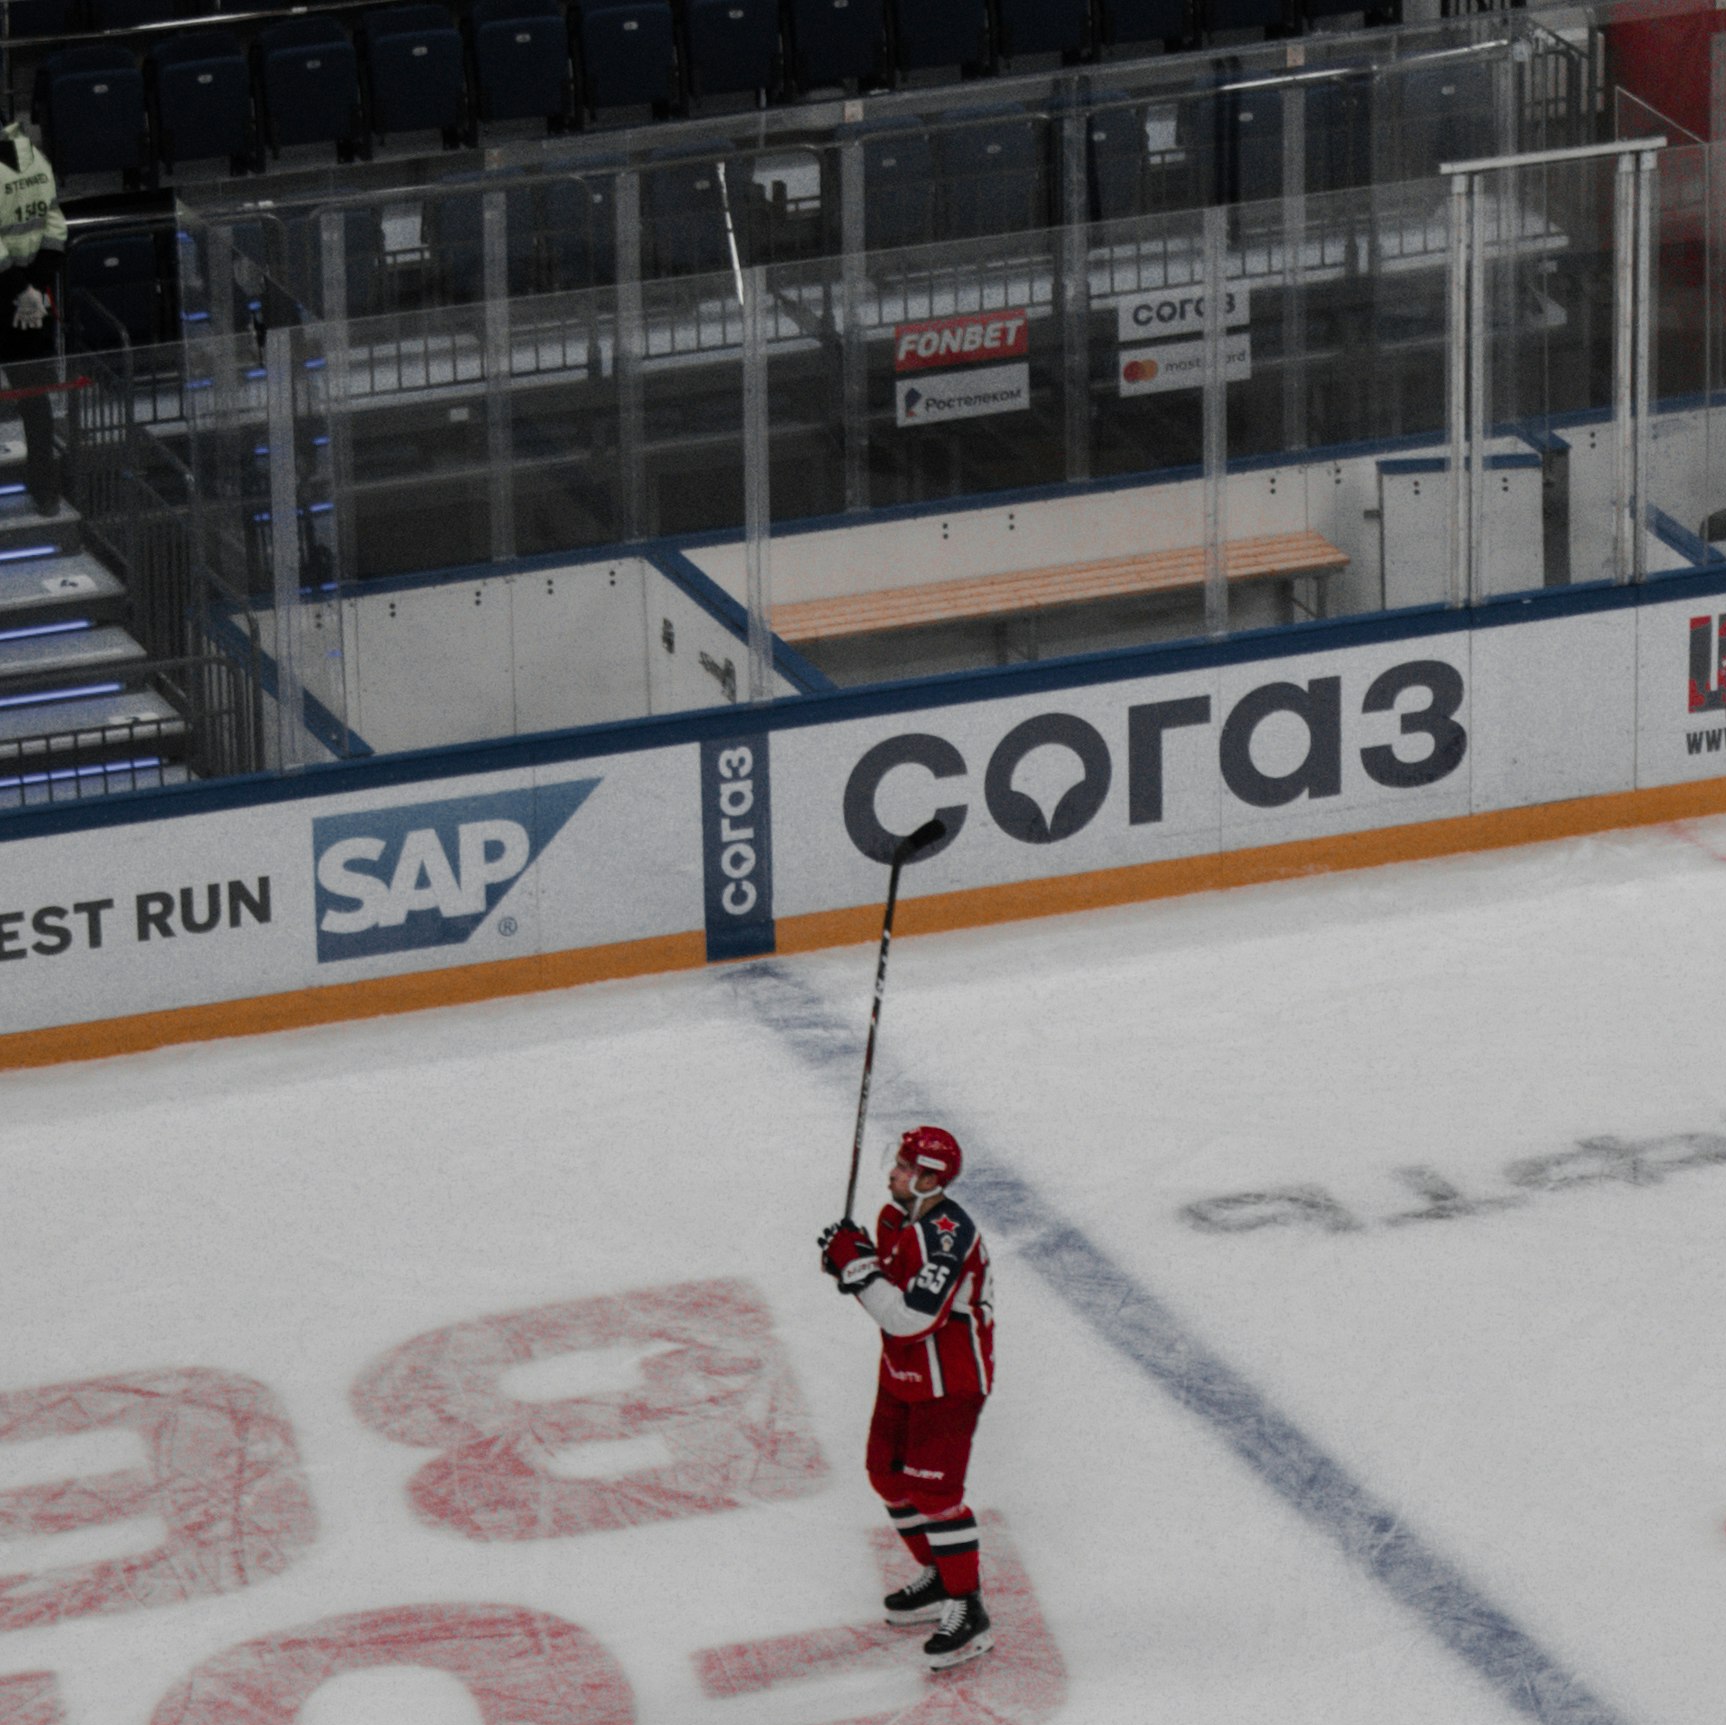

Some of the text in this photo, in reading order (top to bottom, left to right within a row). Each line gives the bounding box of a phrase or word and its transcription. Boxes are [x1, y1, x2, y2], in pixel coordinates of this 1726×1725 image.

[897, 318, 1026, 362] FONBET
[923, 386, 1023, 414] Ростелеком
[316, 817, 531, 934] SAP
[136, 874, 272, 943] RUN
[915, 1262, 951, 1295] 55
